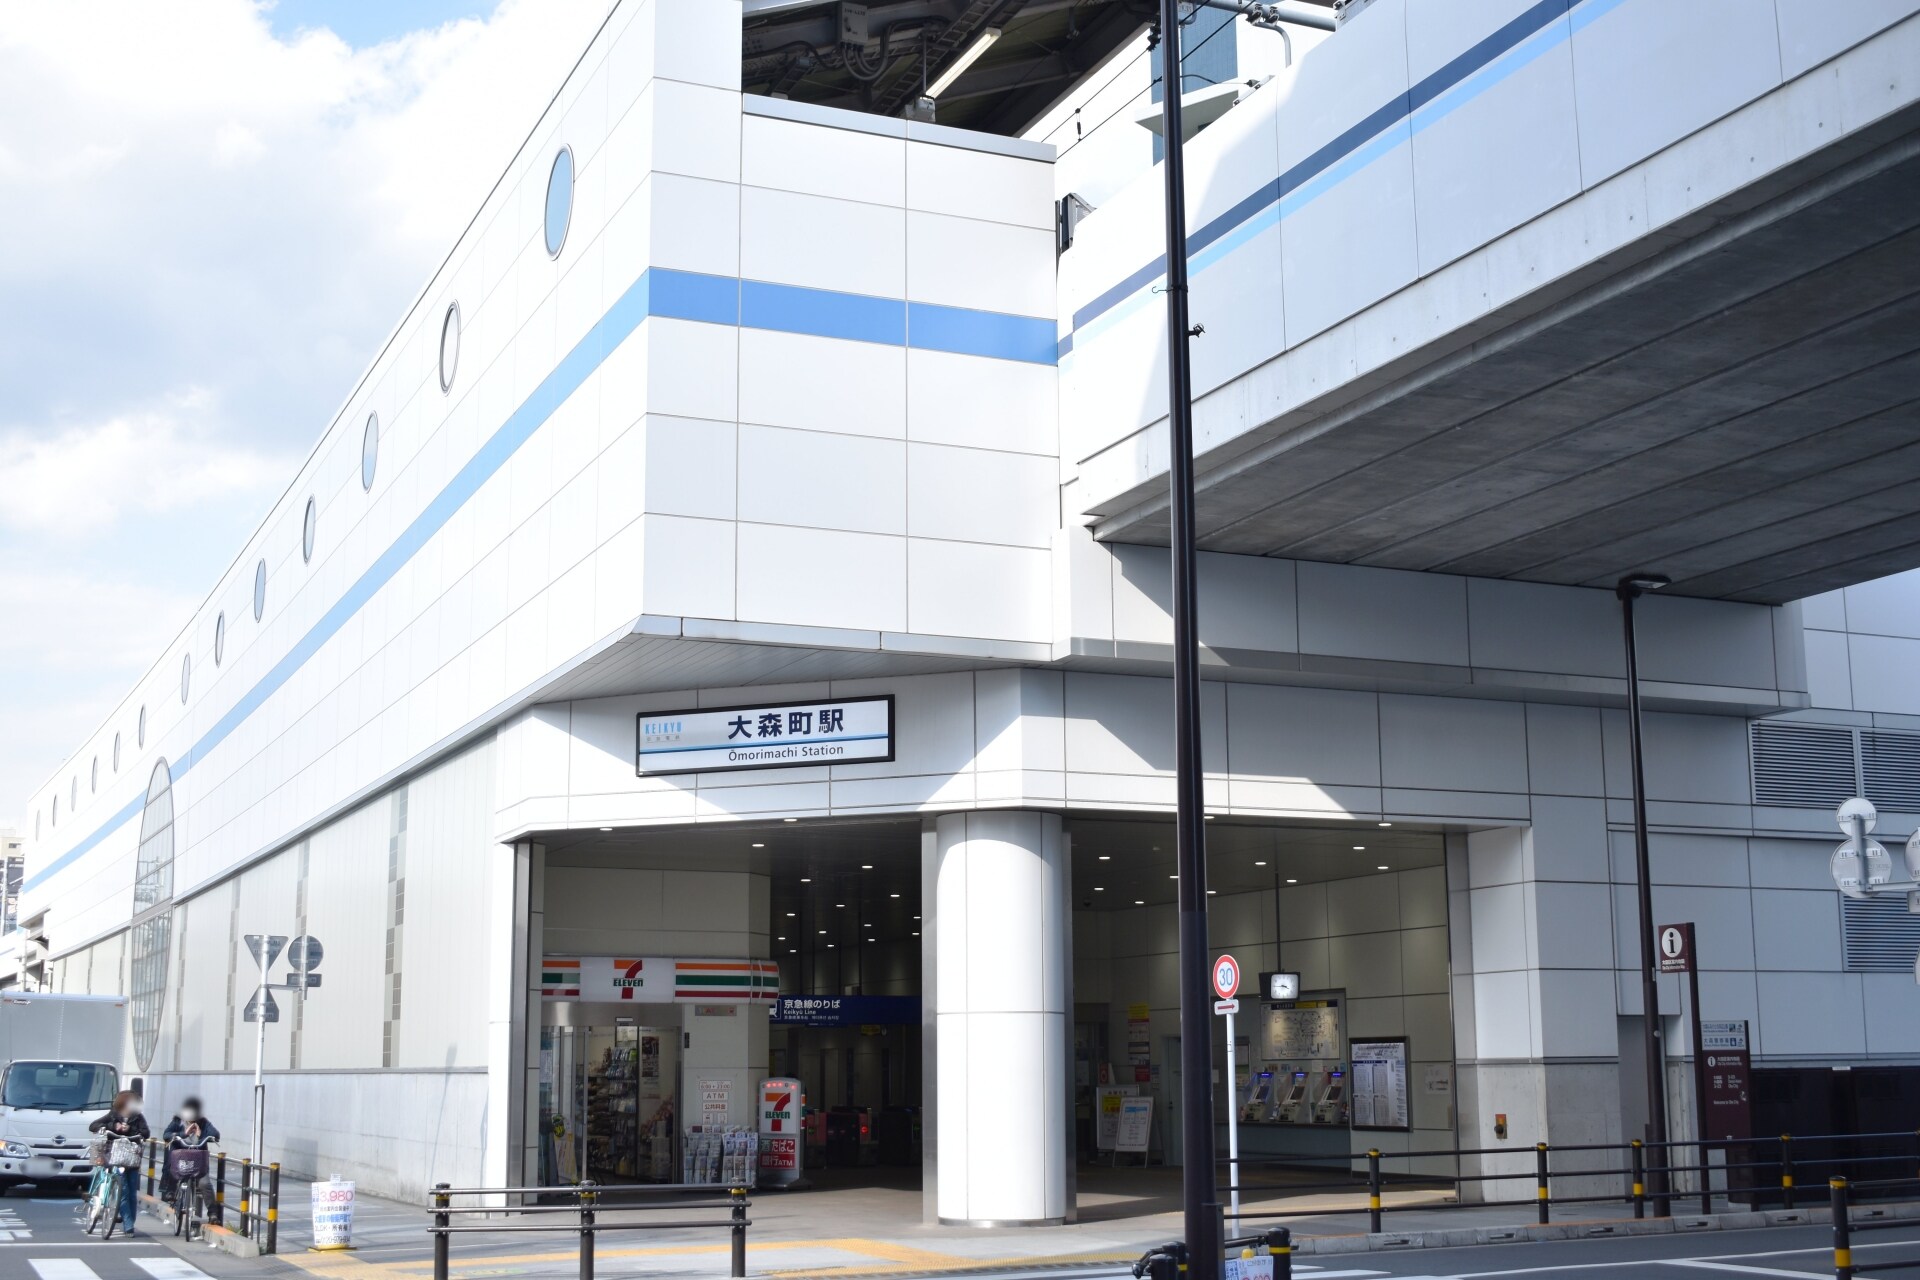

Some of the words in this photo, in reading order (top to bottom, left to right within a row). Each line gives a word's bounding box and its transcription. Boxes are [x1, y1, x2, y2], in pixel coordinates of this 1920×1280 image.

[645, 721, 682, 735] KEIKYU
[728, 708, 845, 740] 大森町駅
[728, 746, 798, 761] Ōmorimachi
[802, 745, 844, 757] Station
[1219, 967, 1233, 987] 30
[783, 999, 841, 1009] 京急線のりば
[706, 1092, 725, 1100] ATM
